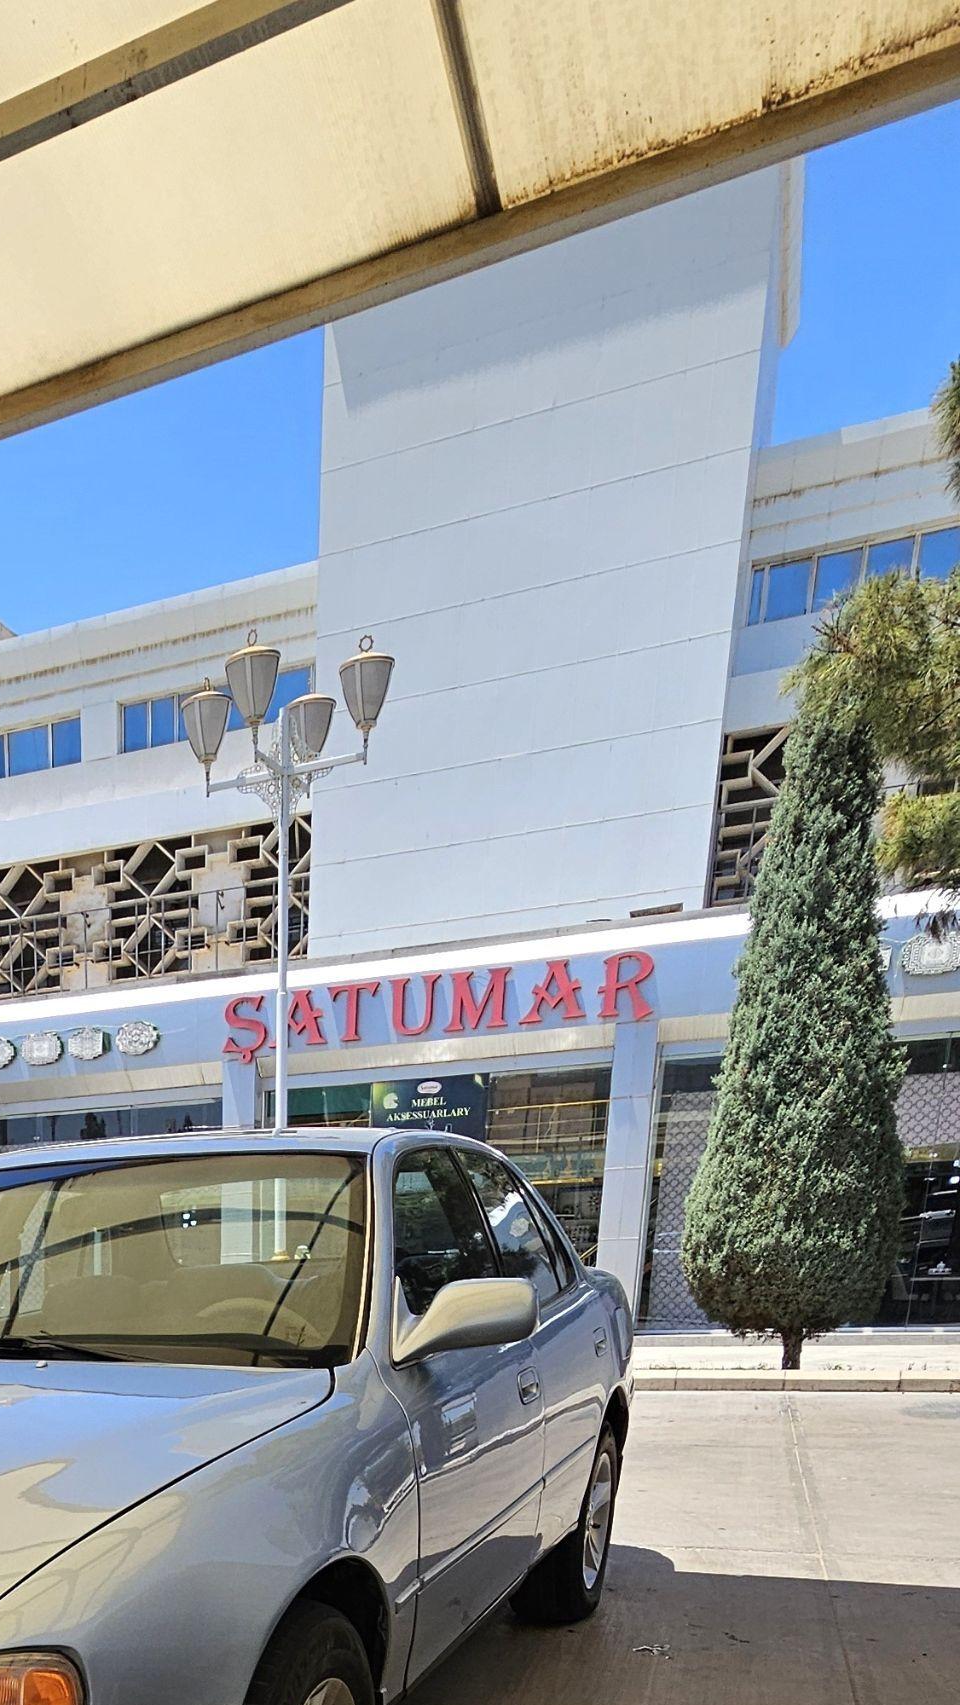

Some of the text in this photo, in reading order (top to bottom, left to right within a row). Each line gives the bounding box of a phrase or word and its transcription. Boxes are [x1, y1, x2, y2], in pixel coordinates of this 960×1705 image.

[223, 950, 655, 1063] ŞATUMAR
[411, 1096, 447, 1108] MEBEL
[386, 1107, 471, 1122] AKSESSUARLARY
